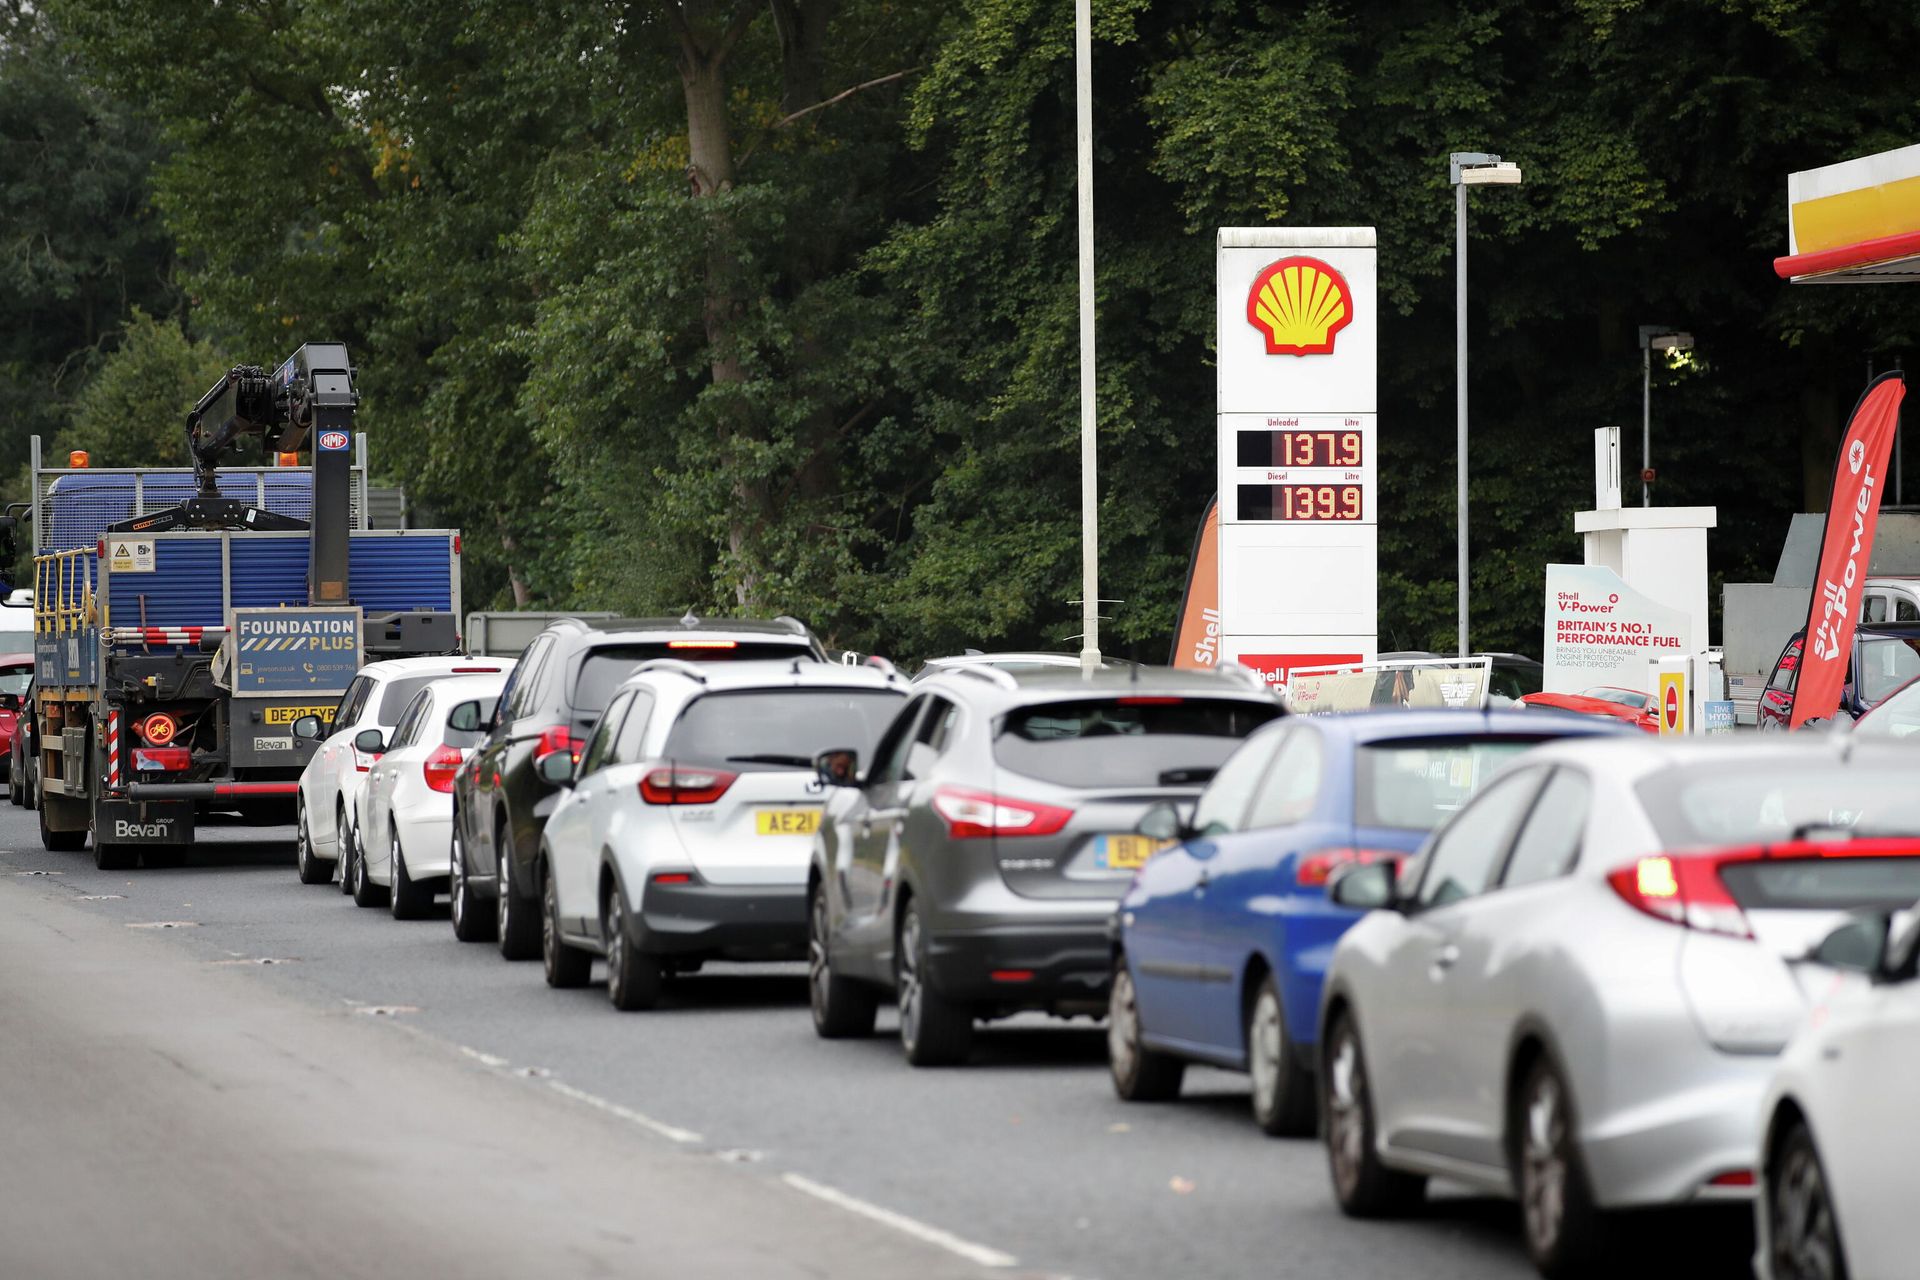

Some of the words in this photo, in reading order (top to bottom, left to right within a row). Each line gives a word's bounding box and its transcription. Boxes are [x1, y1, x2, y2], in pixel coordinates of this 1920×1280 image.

[1267, 418, 1299, 427] Unleaded
[1344, 418, 1360, 427] Litre
[323, 434, 344, 448] HMF
[1284, 433, 1360, 465] 137.9
[1267, 472, 1288, 480] Diesel
[1344, 472, 1360, 480] Litre
[1284, 487, 1360, 519] 139.9
[1825, 464, 1876, 662] V-Power
[1557, 592, 1579, 601] Shell
[1558, 601, 1614, 613] V-Power
[1814, 579, 1838, 660] Shell
[240, 620, 354, 635] FOUNDATION
[1621, 623, 1652, 634] NO.1
[309, 636, 355, 651] PLUS
[1194, 607, 1219, 666] Shell
[1557, 633, 1649, 647] PERFORMANCE
[1653, 636, 1682, 648] FUEL
[1556, 646, 1581, 654] BRINGS
[1583, 647, 1597, 655] YOU
[1598, 648, 1637, 656] UNBEATABLE
[1556, 653, 1582, 661] ENGINE
[1583, 654, 1625, 663] PROTECTION
[1556, 660, 1586, 668] AGAINST
[1250, 668, 1284, 682] hell
[256, 739, 287, 750] Bevan
[115, 819, 168, 837] Bevan
[769, 813, 813, 832] AE21
